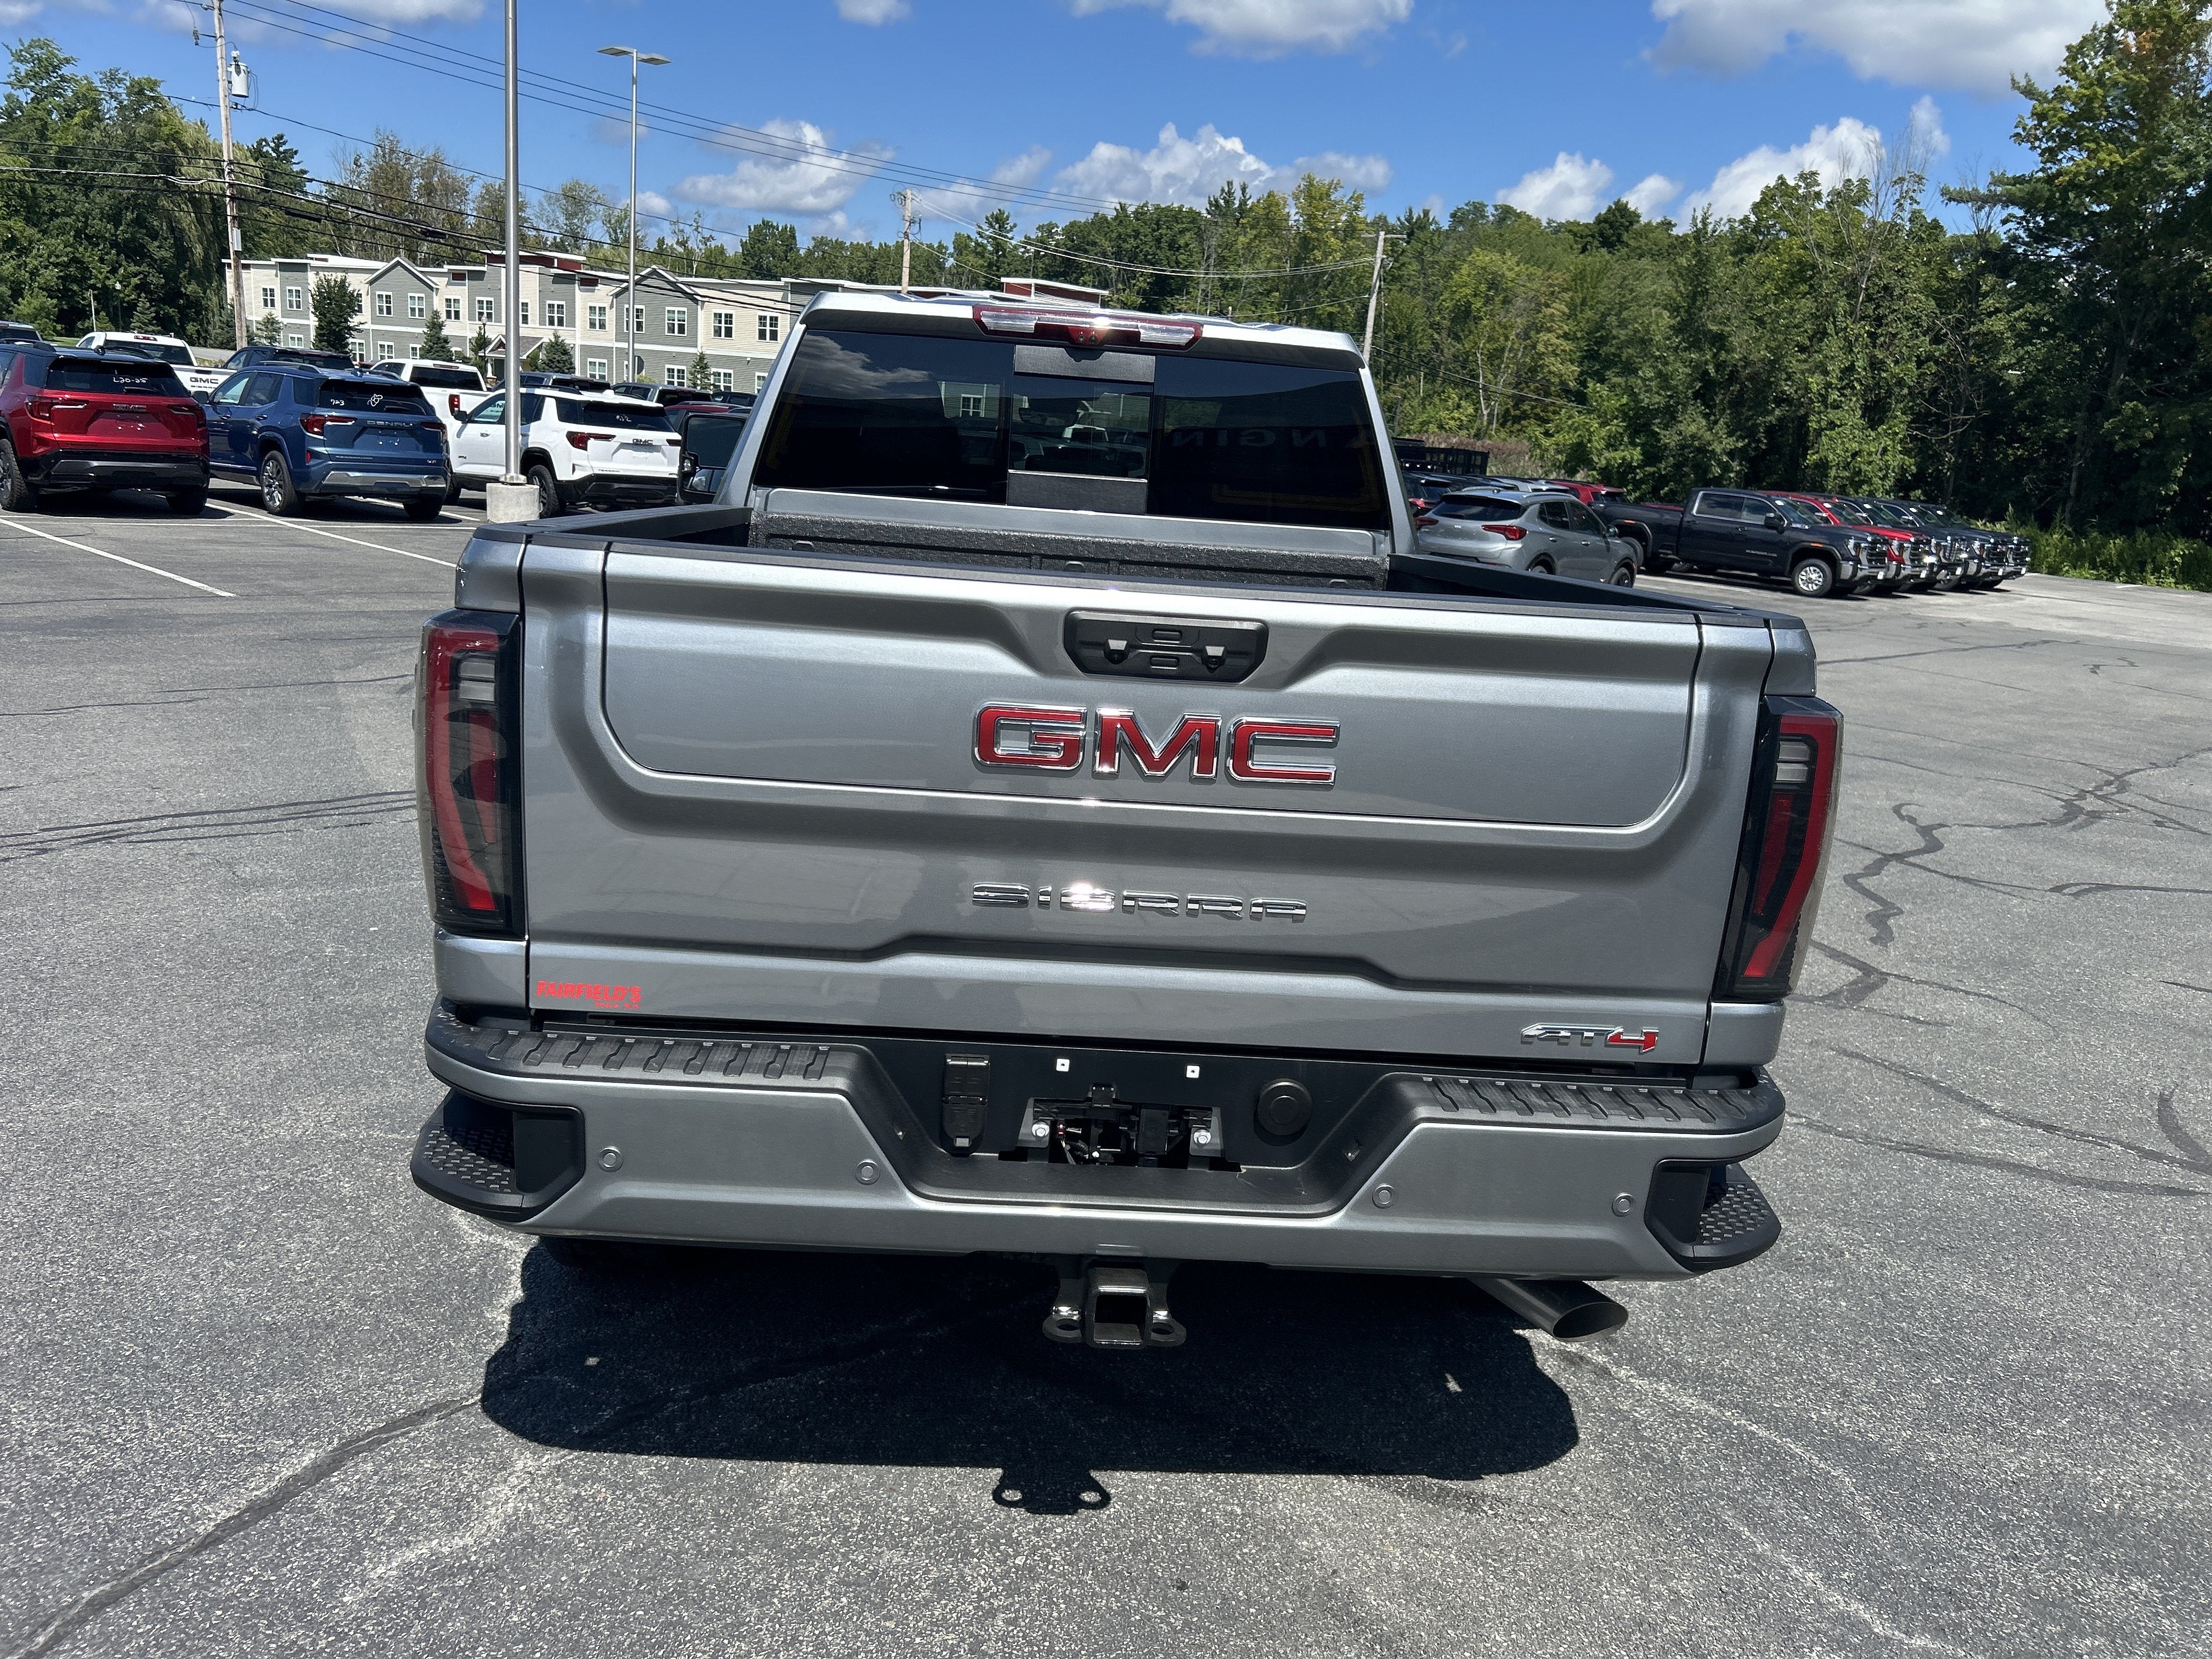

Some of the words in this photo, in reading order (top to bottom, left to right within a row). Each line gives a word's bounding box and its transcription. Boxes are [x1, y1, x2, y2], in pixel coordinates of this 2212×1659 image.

[113, 403, 147, 412] GMC
[973, 701, 1340, 786] GMC
[972, 882, 1307, 923] SIERRA
[535, 980, 641, 1002] FAIRFIELD'S
[1521, 1023, 1659, 1055] AT4
